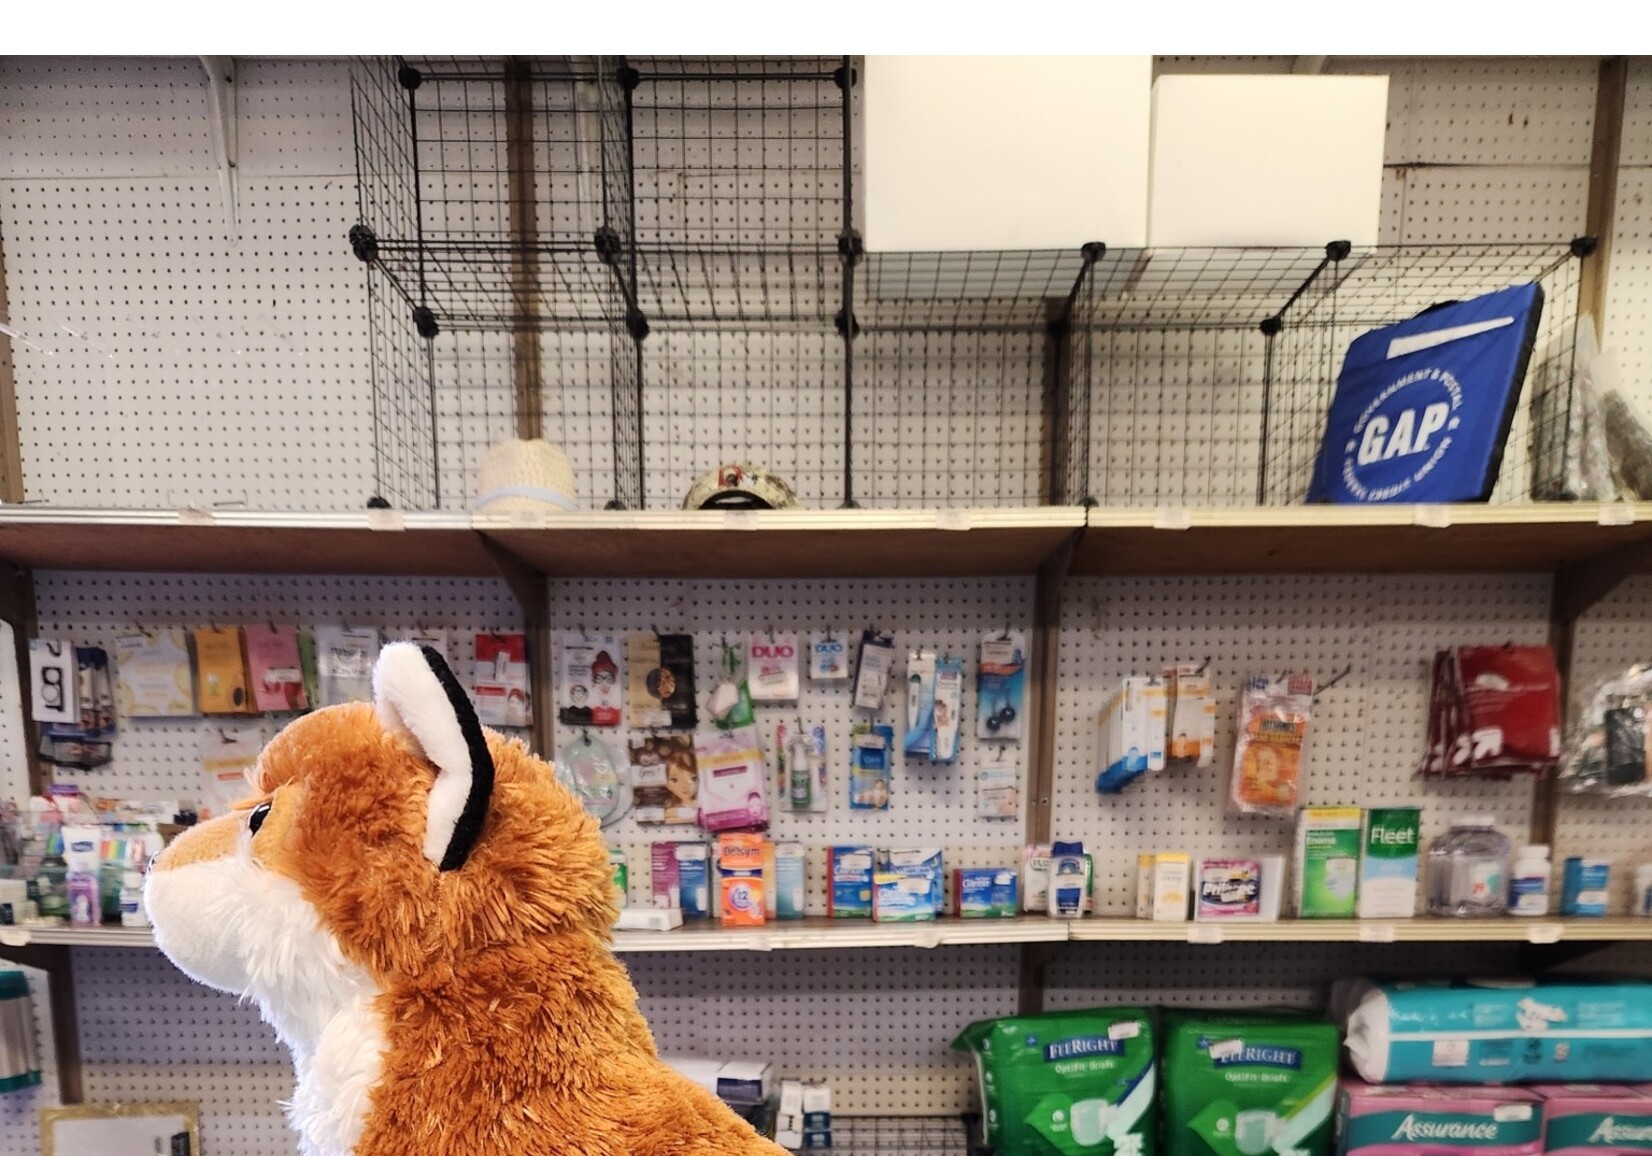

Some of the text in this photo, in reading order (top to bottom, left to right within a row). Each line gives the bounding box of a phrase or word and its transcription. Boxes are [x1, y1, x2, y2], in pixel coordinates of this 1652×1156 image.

[1357, 401, 1450, 466] GAP
[752, 645, 794, 659] DUO
[815, 643, 843, 653] DUO
[1370, 824, 1416, 844] Fleet
[724, 846, 760, 858] Delsym
[737, 890, 748, 901] 12
[1390, 1114, 1498, 1142] Assurance
